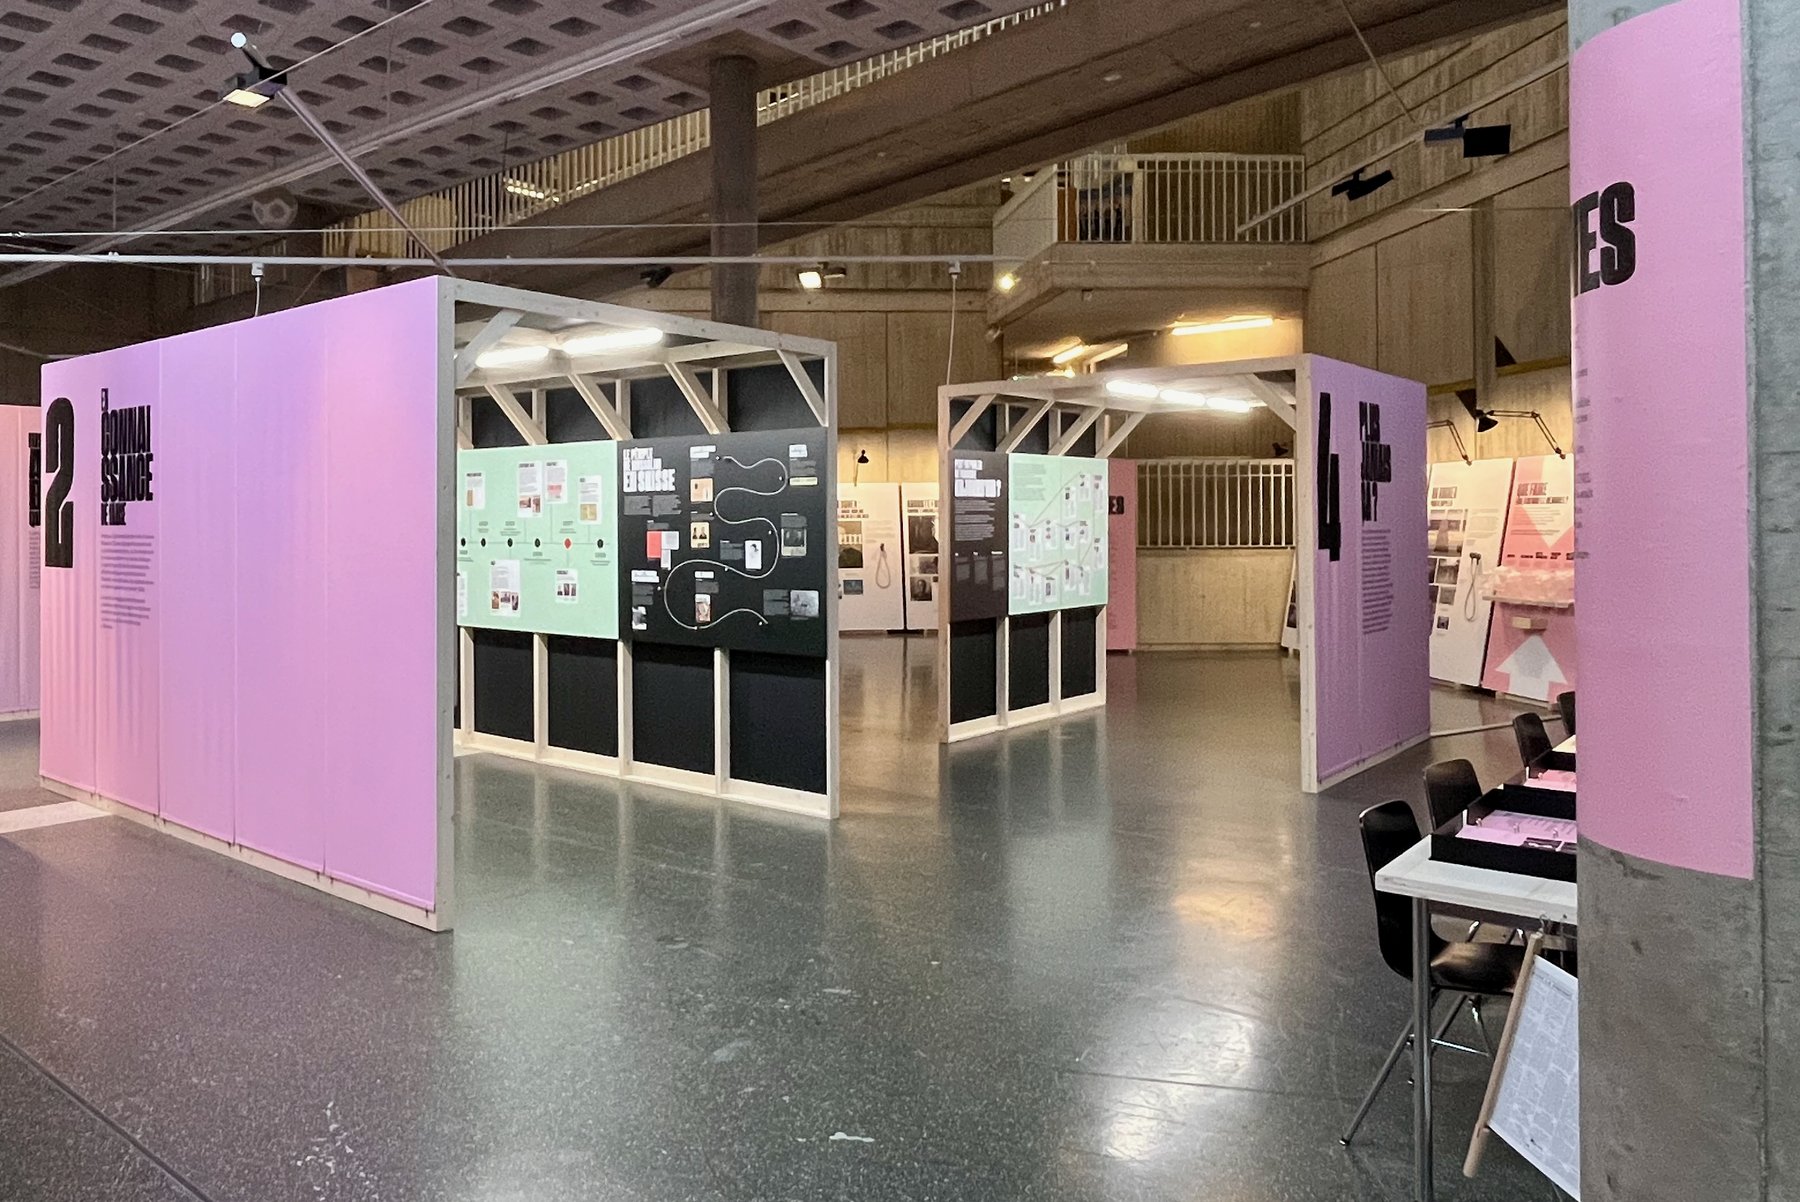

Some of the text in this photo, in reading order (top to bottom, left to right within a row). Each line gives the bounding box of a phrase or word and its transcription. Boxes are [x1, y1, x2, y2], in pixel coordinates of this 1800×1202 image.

[1572, 181, 1636, 297] ES
[101, 405, 151, 457] CONNAI
[45, 397, 75, 568] 2
[101, 453, 154, 502] SSANCE
